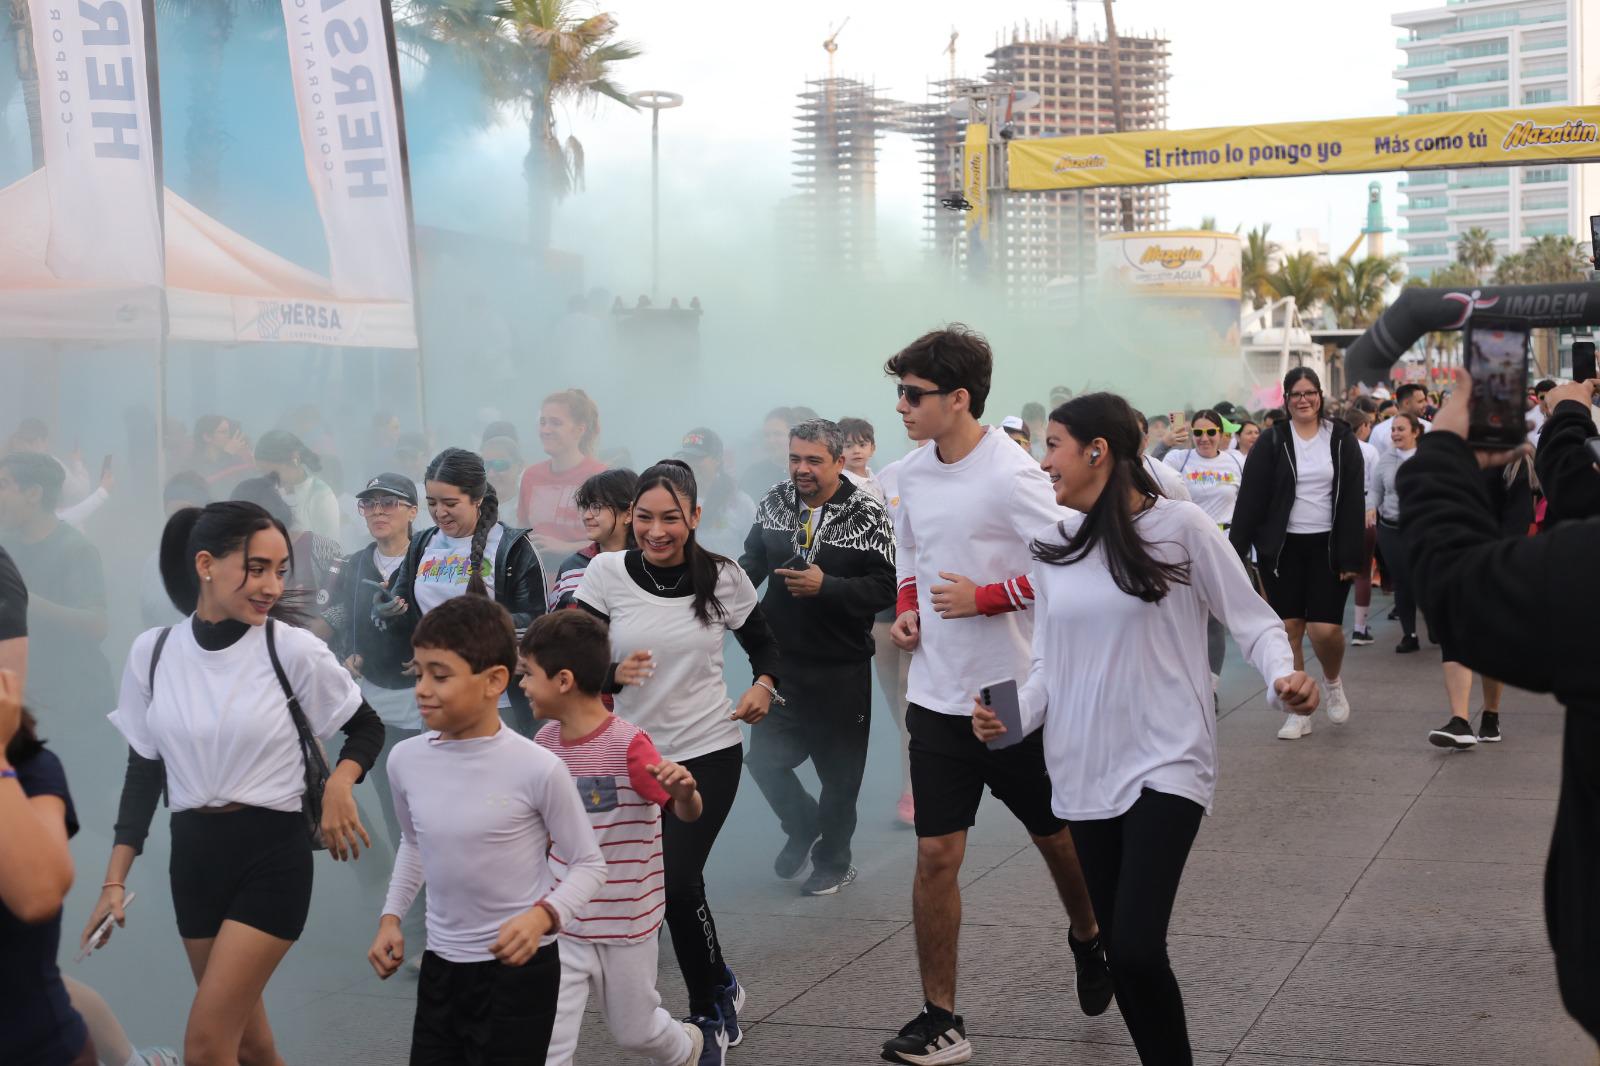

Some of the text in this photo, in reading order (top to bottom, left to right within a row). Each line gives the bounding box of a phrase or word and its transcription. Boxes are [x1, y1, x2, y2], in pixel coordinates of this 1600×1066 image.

[1144, 141, 1342, 168] El ritmo lo pongo yo
[1374, 128, 1488, 155] Más como tú
[281, 303, 342, 329] HERSA
[1504, 292, 1589, 316] IMDEM
